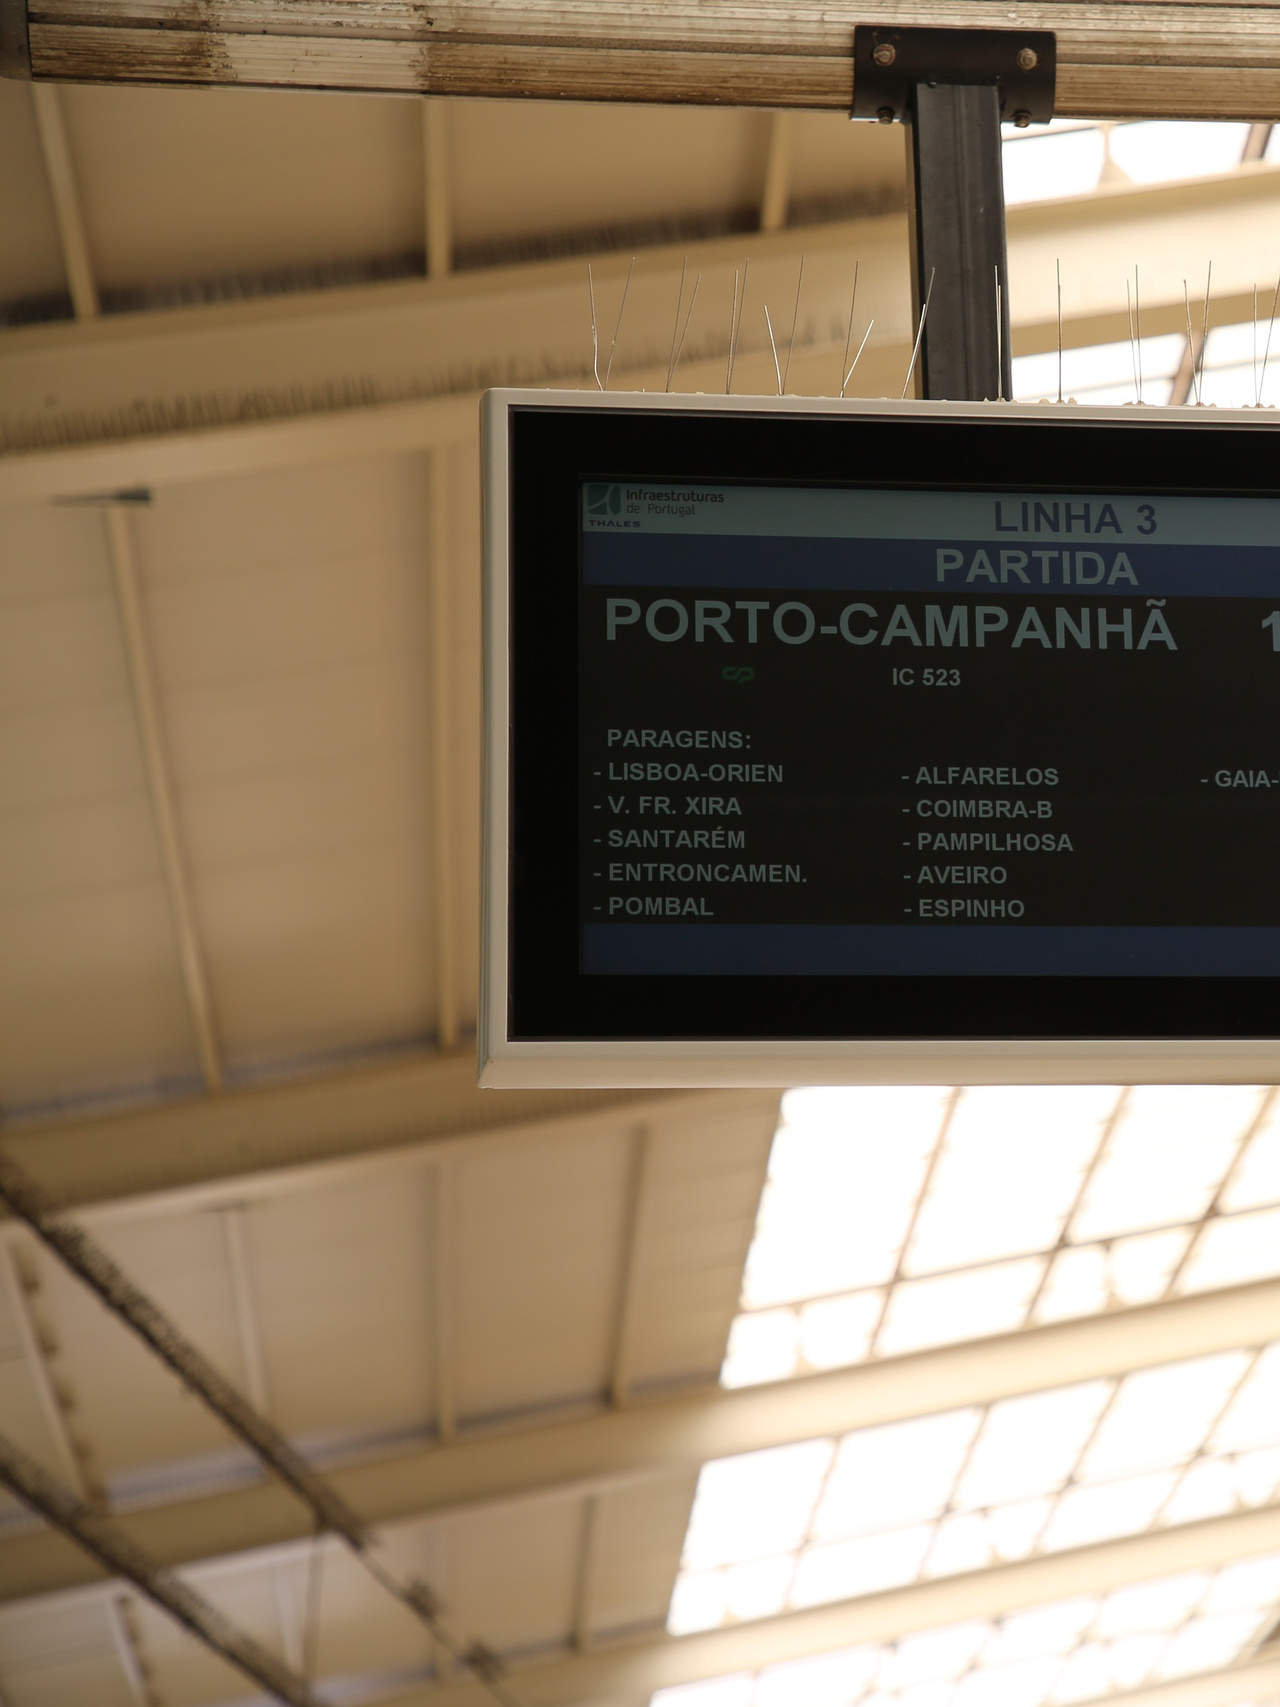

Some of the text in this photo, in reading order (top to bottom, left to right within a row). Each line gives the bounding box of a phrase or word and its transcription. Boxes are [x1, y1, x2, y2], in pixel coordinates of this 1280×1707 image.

[626, 488, 726, 504] Infraestruturas
[626, 502, 696, 518] de Portugal
[994, 500, 1157, 536] LINHA 3
[588, 519, 641, 528] THALES
[936, 548, 1139, 586] PARTIDA
[606, 598, 1178, 651] PORTO-CAMPANHÃ
[892, 667, 961, 687] IC 523
[607, 728, 751, 749] PARAGENS:
[609, 762, 783, 783] LISBOA-ORIEN
[915, 766, 1059, 786] ALFARELOS
[607, 795, 630, 814] V.
[639, 796, 677, 815] FR.
[685, 796, 742, 816] XIRA
[916, 799, 1053, 819] COIMBRA-B
[608, 825, 745, 849] SANTARÉM
[917, 832, 1074, 852] PAMPILHOSA
[609, 863, 807, 883] ENTRONCAMEN.
[917, 865, 1008, 884] AVEIRO
[609, 896, 714, 916] POMBAL
[919, 898, 1025, 918] ESPINHO
